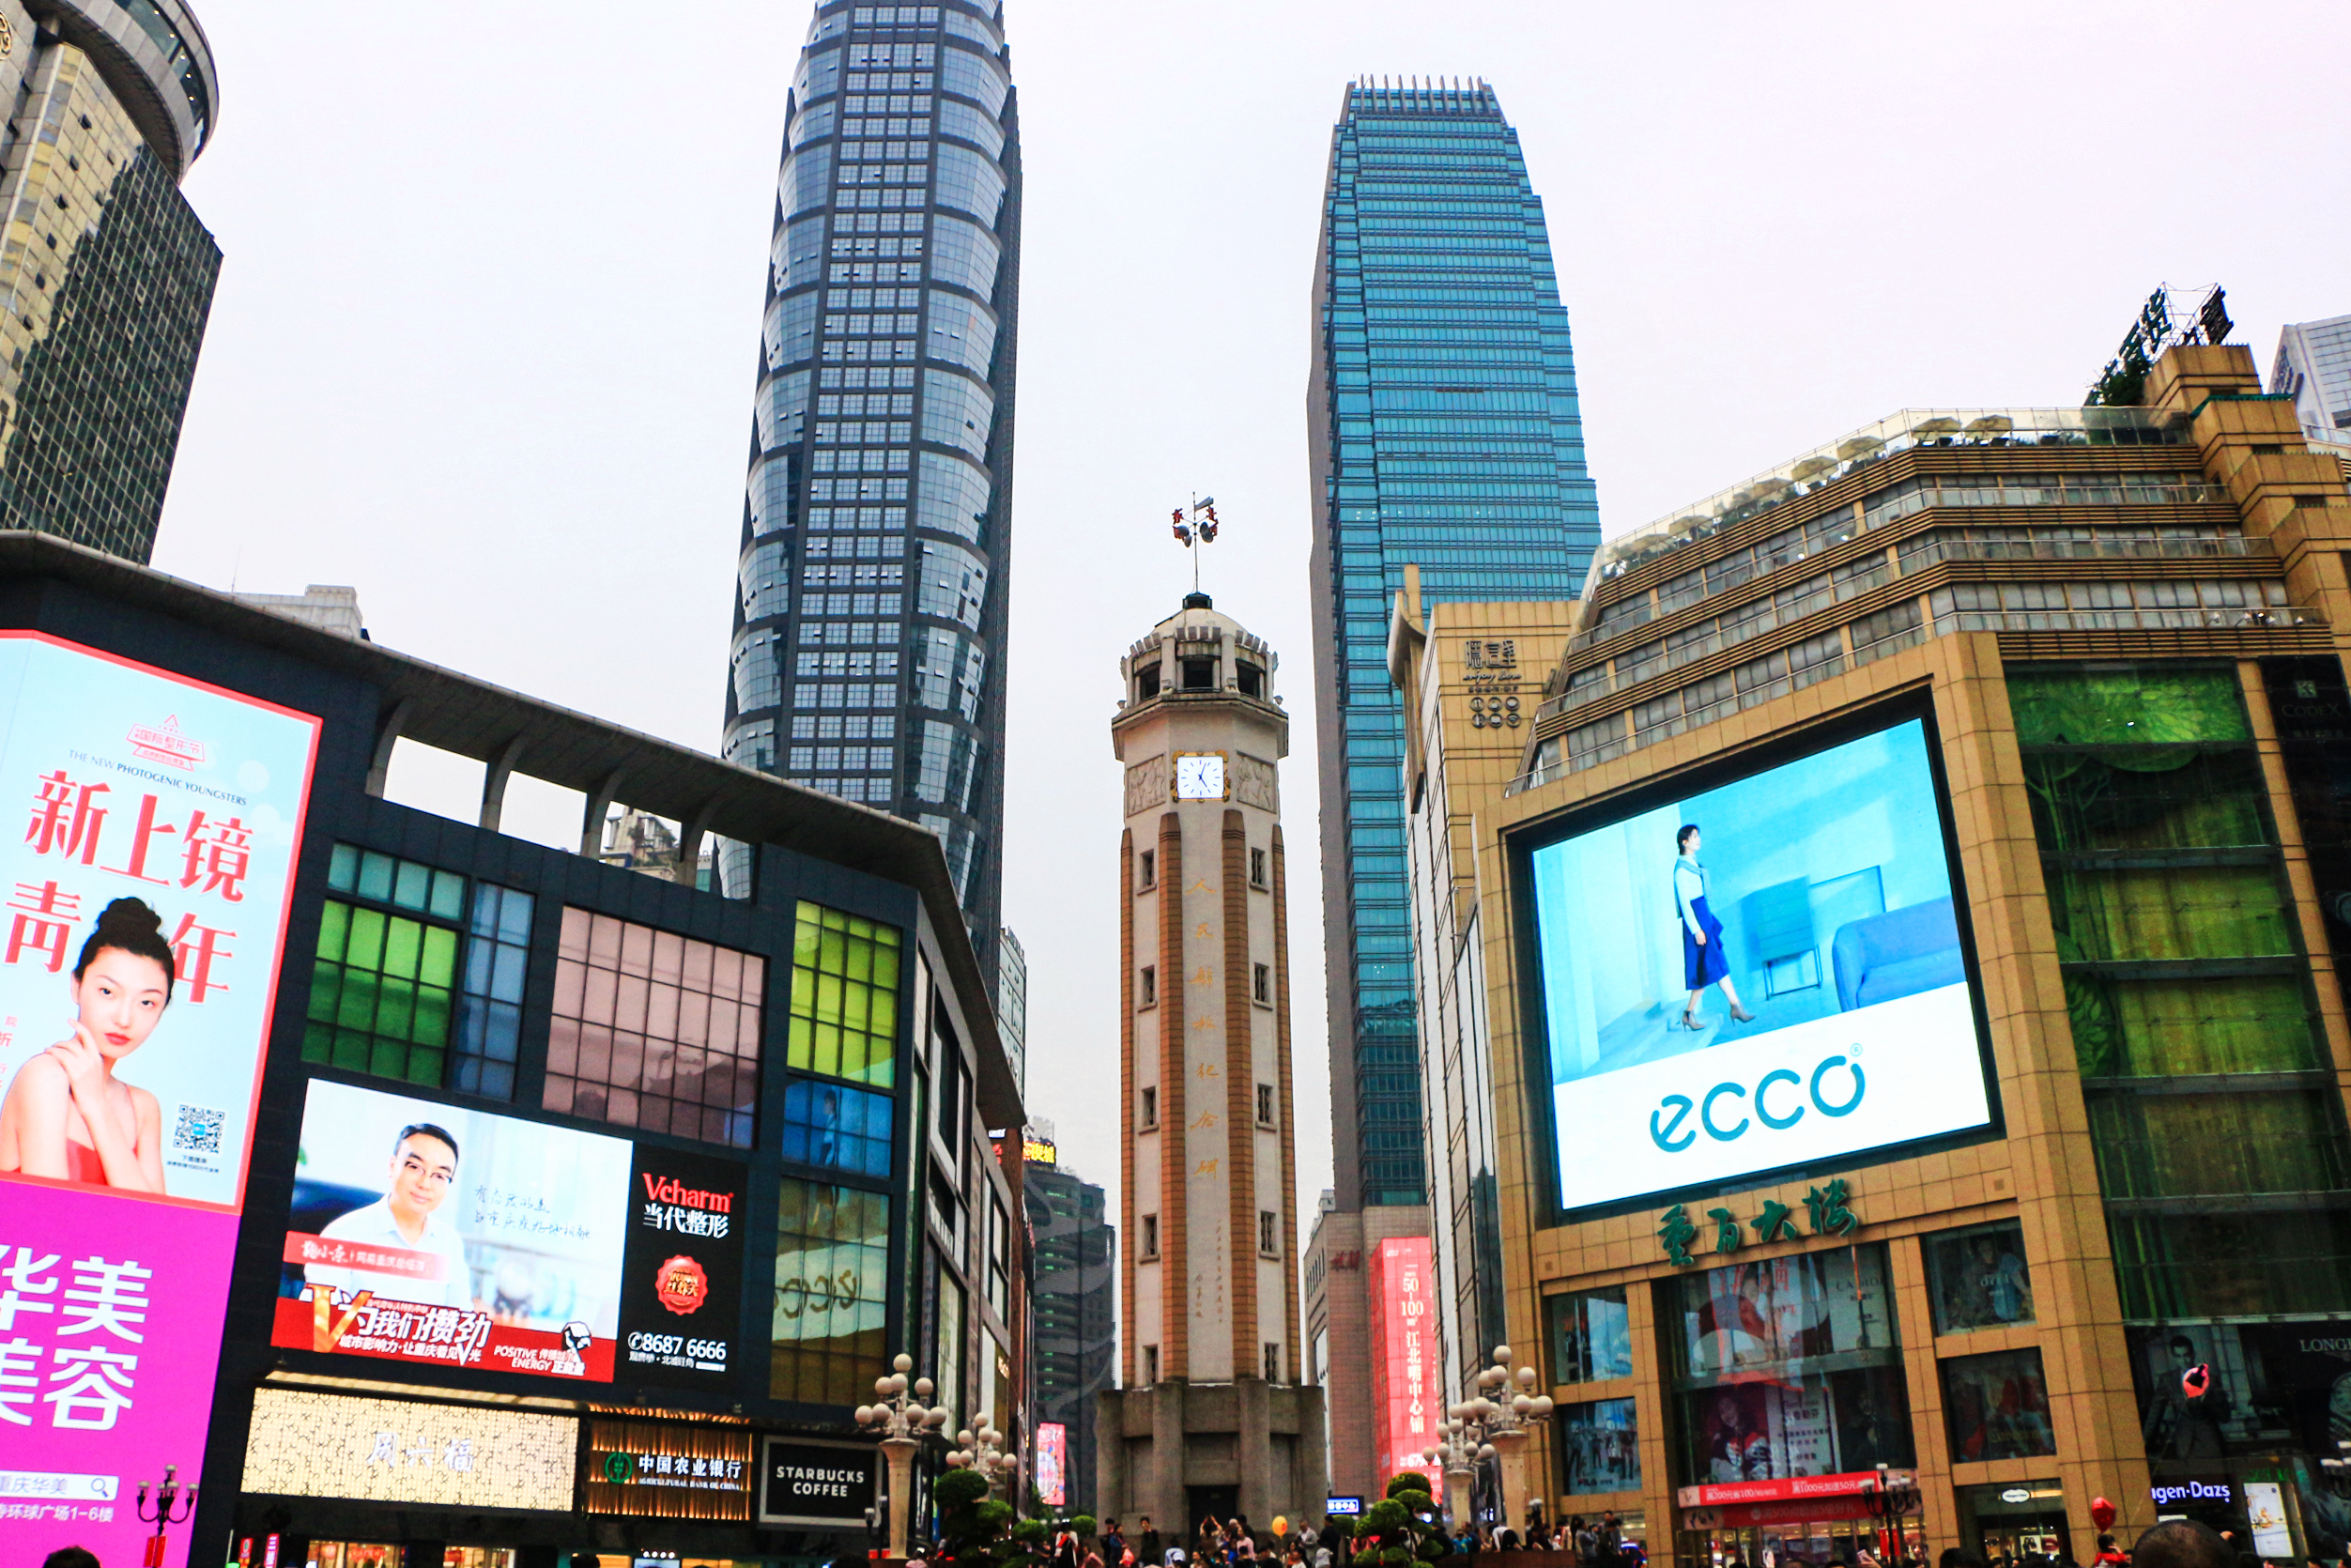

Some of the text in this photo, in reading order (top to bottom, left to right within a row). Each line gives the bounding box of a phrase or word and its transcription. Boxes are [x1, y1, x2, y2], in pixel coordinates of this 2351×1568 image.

[69, 749, 247, 807] THE NEW PHOTOGENIC YOUNGSTERS
[23, 769, 254, 903] 新上镜
[1650, 1054, 1866, 1153] ecco
[642, 1172, 731, 1214] Vcharm
[642, 1202, 729, 1239] 当代整形
[1657, 1178, 1858, 1267] 重百大楼
[1403, 1277, 1420, 1293] 50
[1401, 1300, 1424, 1316] 100
[494, 1345, 538, 1360] POSITIVE
[641, 1332, 727, 1360] 8687 6666
[511, 1358, 554, 1372] ENERGY
[365, 1431, 474, 1473] 周六福
[638, 1453, 742, 1480] 中国农业银行
[776, 1466, 865, 1483] STARBUCKS
[638, 1477, 689, 1488] AGRICULTURAL
[689, 1480, 709, 1490] BANK
[719, 1482, 740, 1491] CHINA
[792, 1482, 848, 1498] COFFEE
